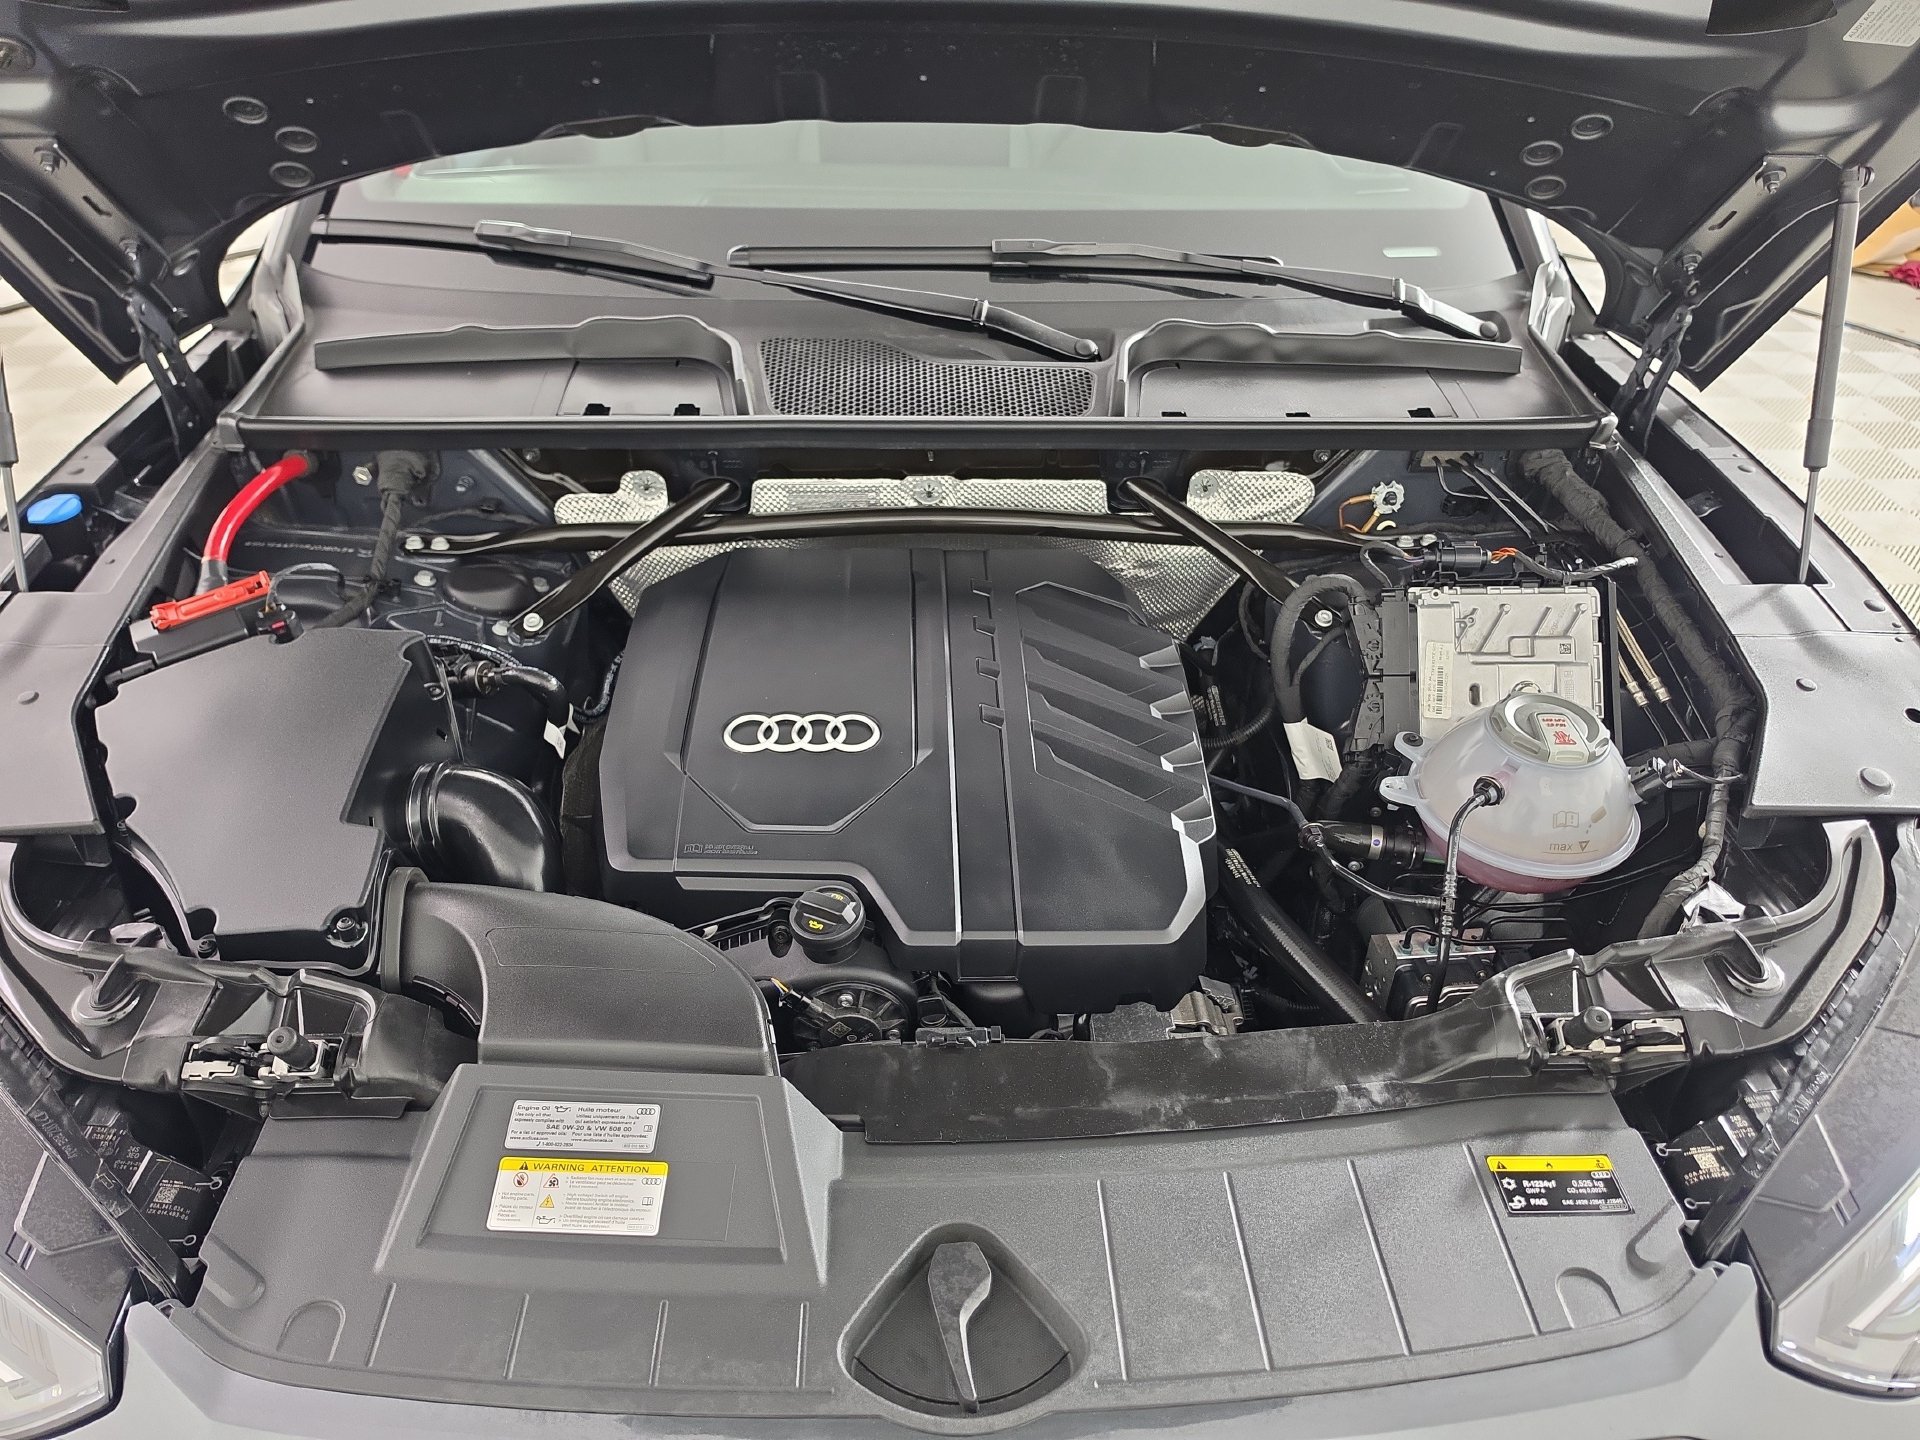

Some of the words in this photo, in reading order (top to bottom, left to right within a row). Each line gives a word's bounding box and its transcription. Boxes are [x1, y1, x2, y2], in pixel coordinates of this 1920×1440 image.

[534, 1163, 584, 1172] WARNING
[591, 1164, 650, 1173] ATTENTION
[1522, 1180, 1556, 1188] R-1234yf
